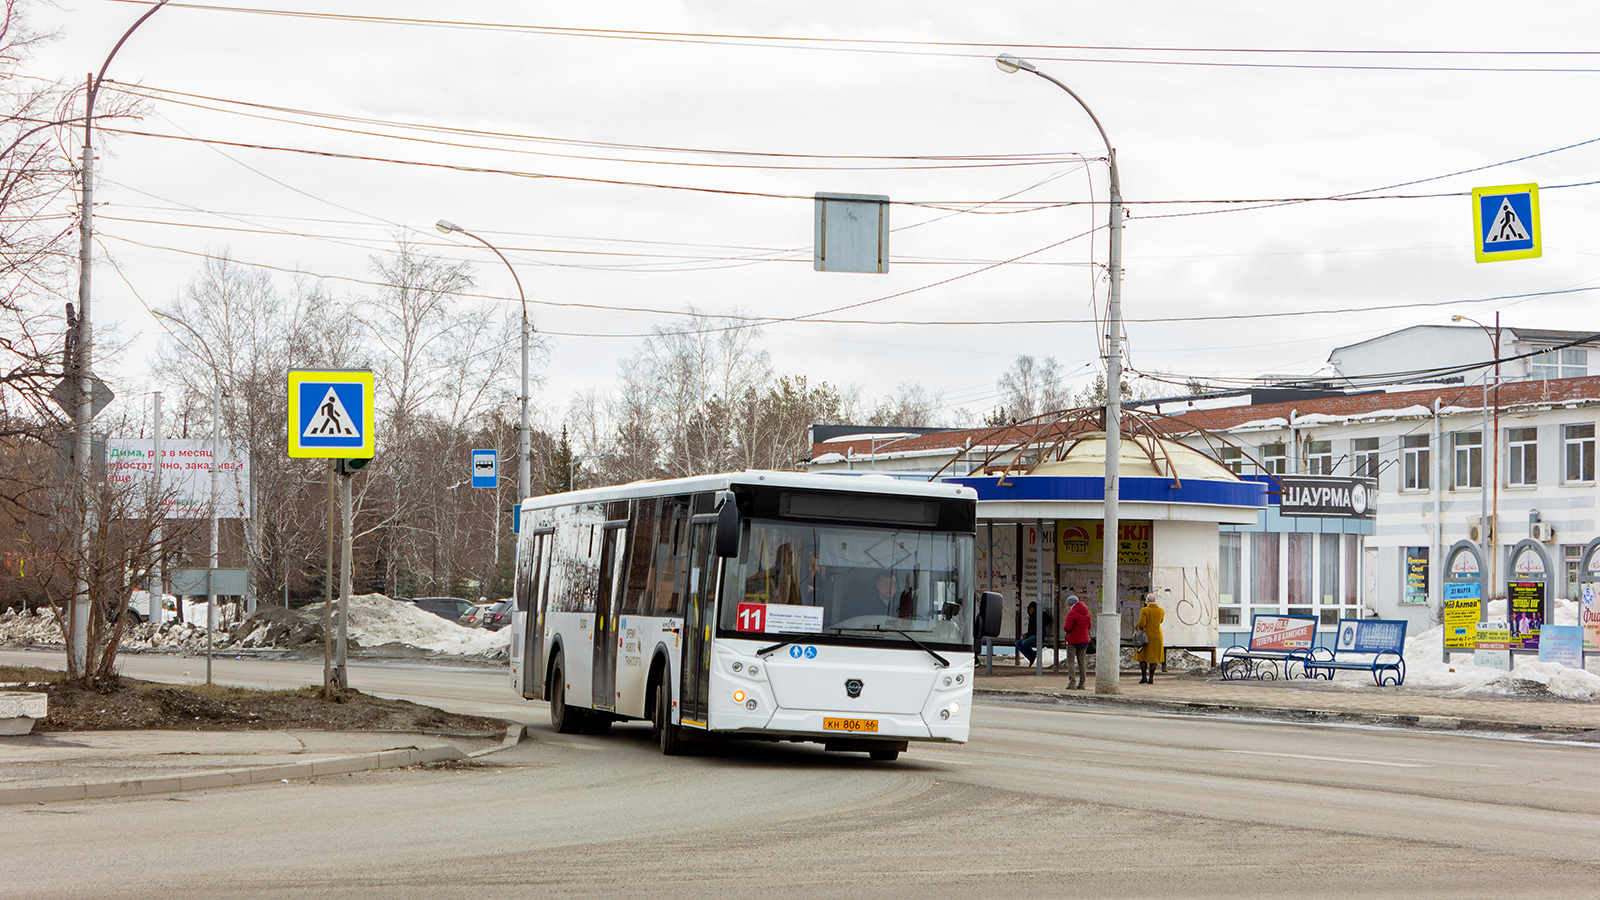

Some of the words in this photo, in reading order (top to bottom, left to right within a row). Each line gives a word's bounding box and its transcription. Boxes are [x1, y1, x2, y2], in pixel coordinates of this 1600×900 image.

[111, 449, 144, 458] Дима,
[148, 450, 166, 458] рз
[1282, 486, 1351, 507] ШАУРМА
[740, 608, 760, 630] 11
[1256, 636, 1273, 646] ТЕПЕРЬ
[1282, 627, 1308, 639] КАМЕНСКЕ
[843, 720, 860, 729] 806
